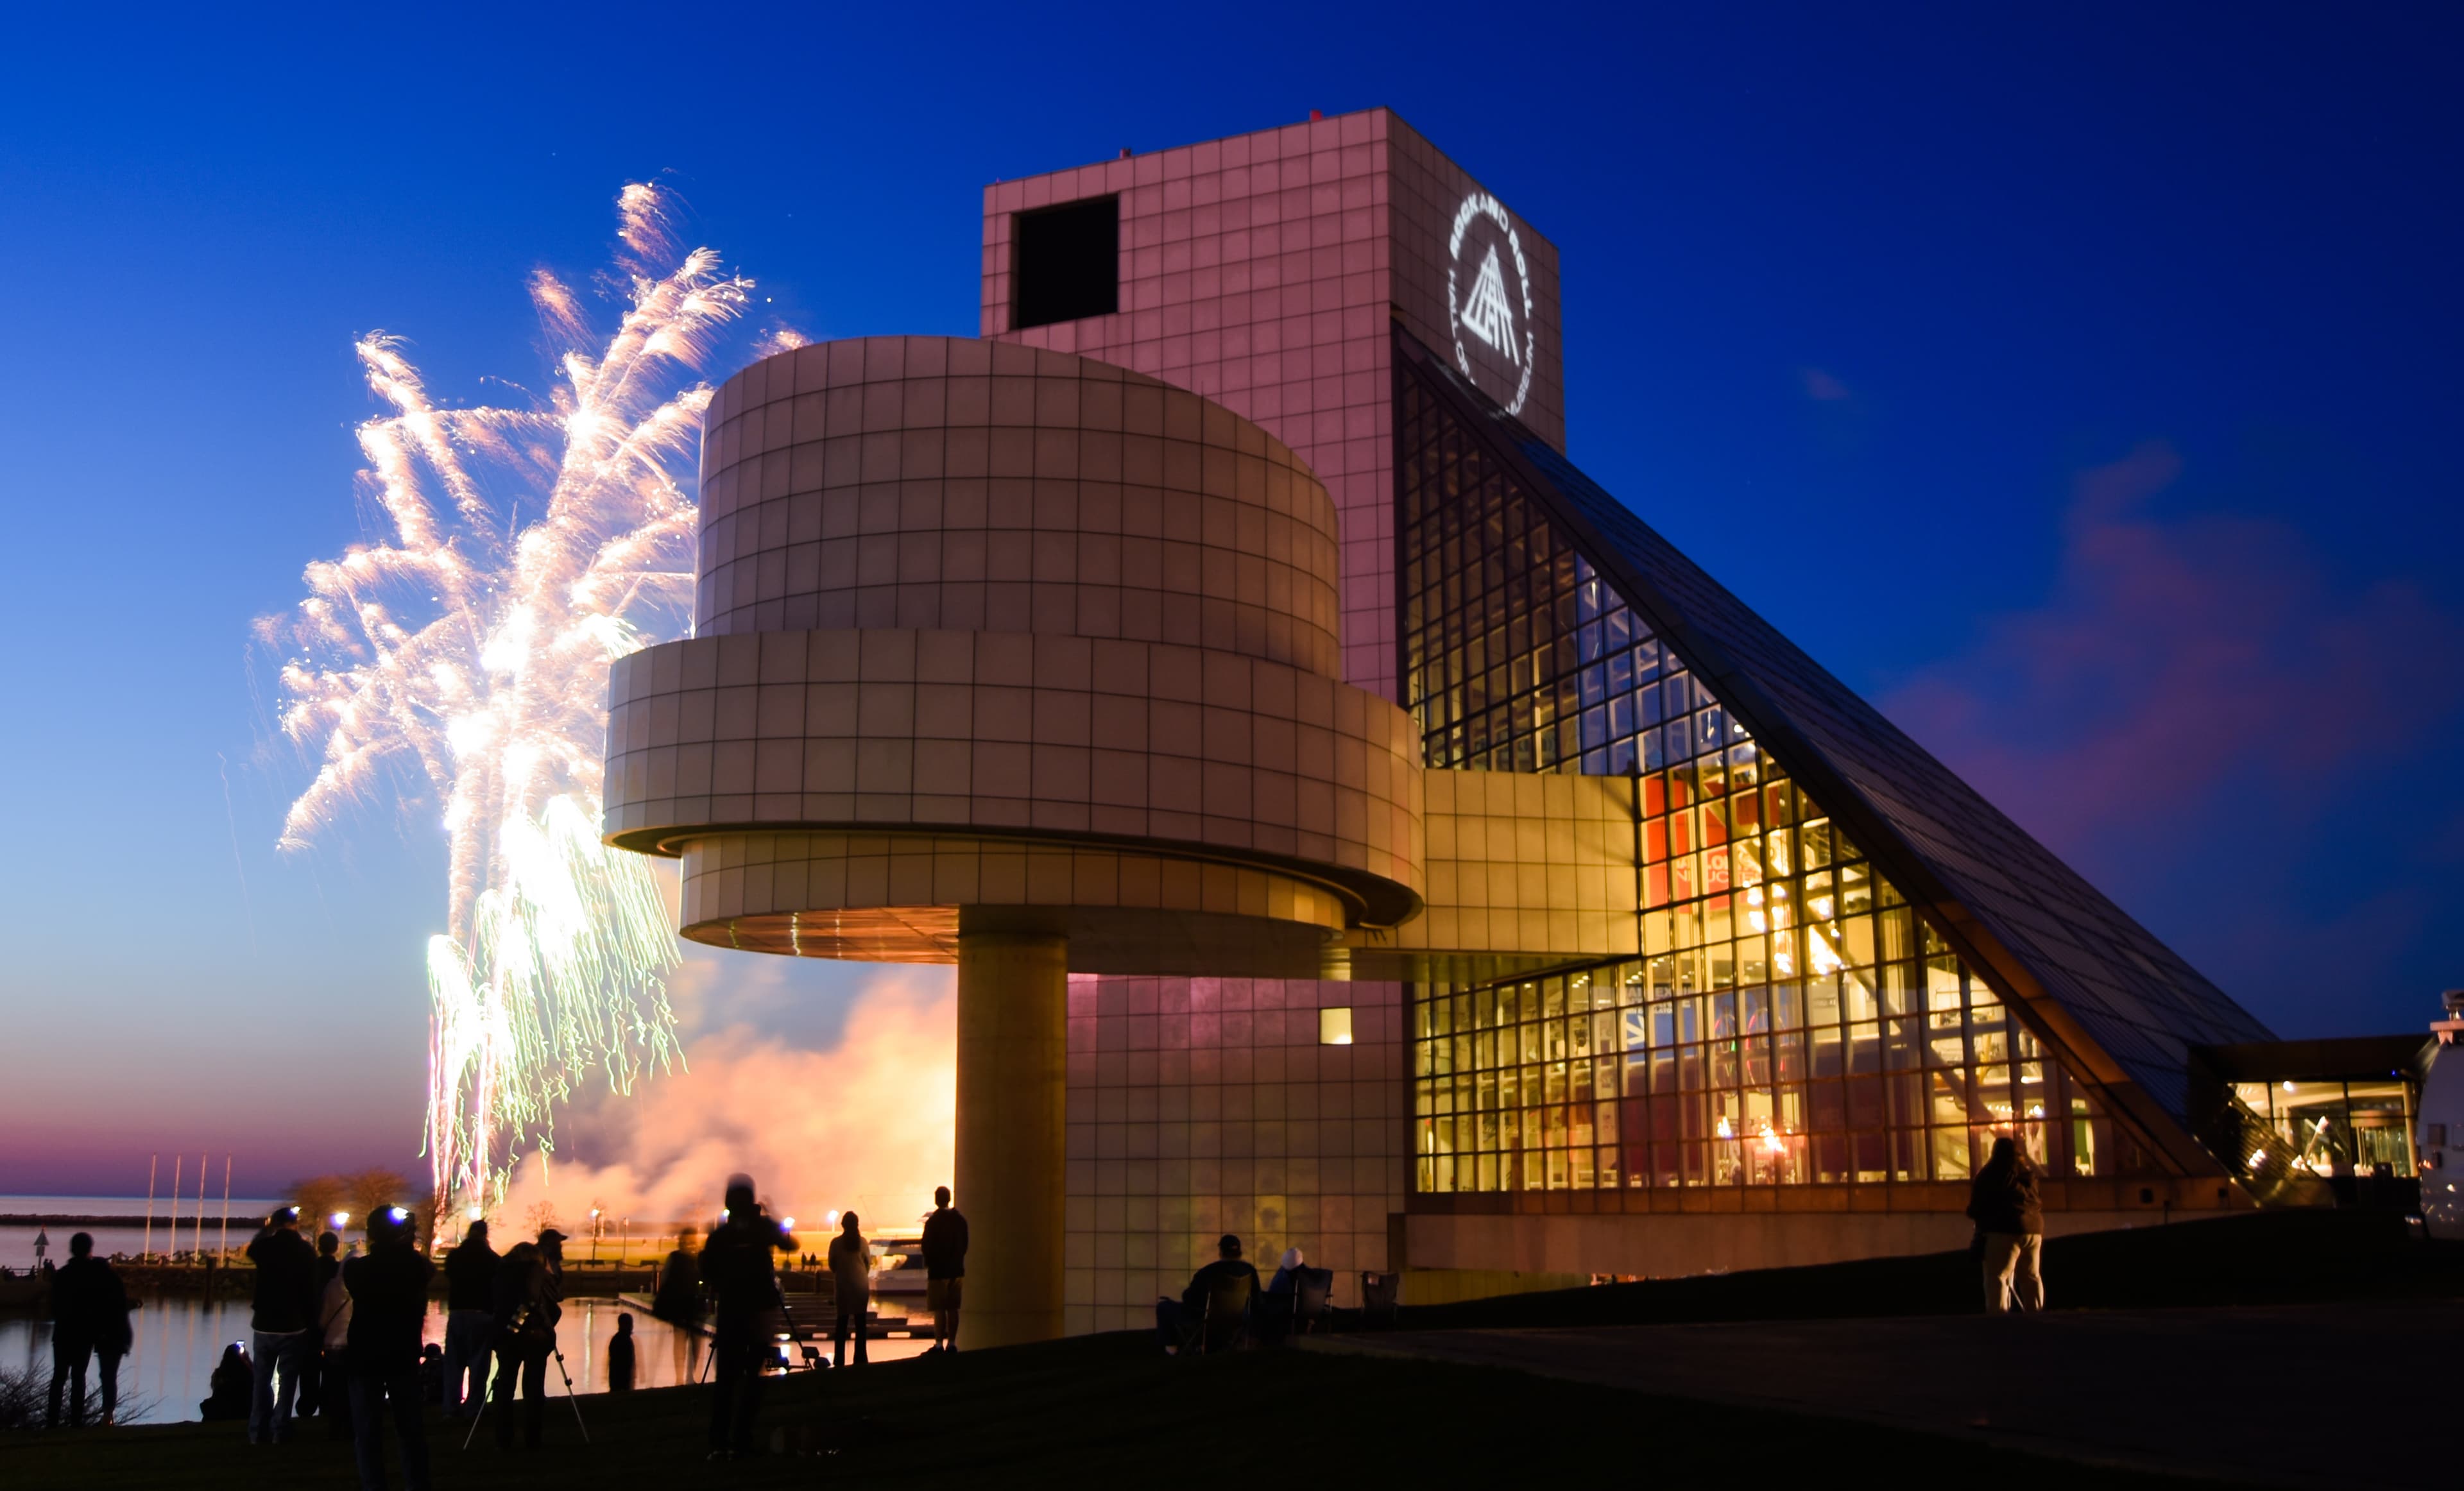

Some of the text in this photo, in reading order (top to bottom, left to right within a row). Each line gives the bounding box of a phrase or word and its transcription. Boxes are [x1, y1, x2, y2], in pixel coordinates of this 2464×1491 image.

[1450, 192, 1533, 319] ROCK AND ROLL
[1448, 269, 1459, 339] HALL
[1456, 340, 1470, 377] OF
